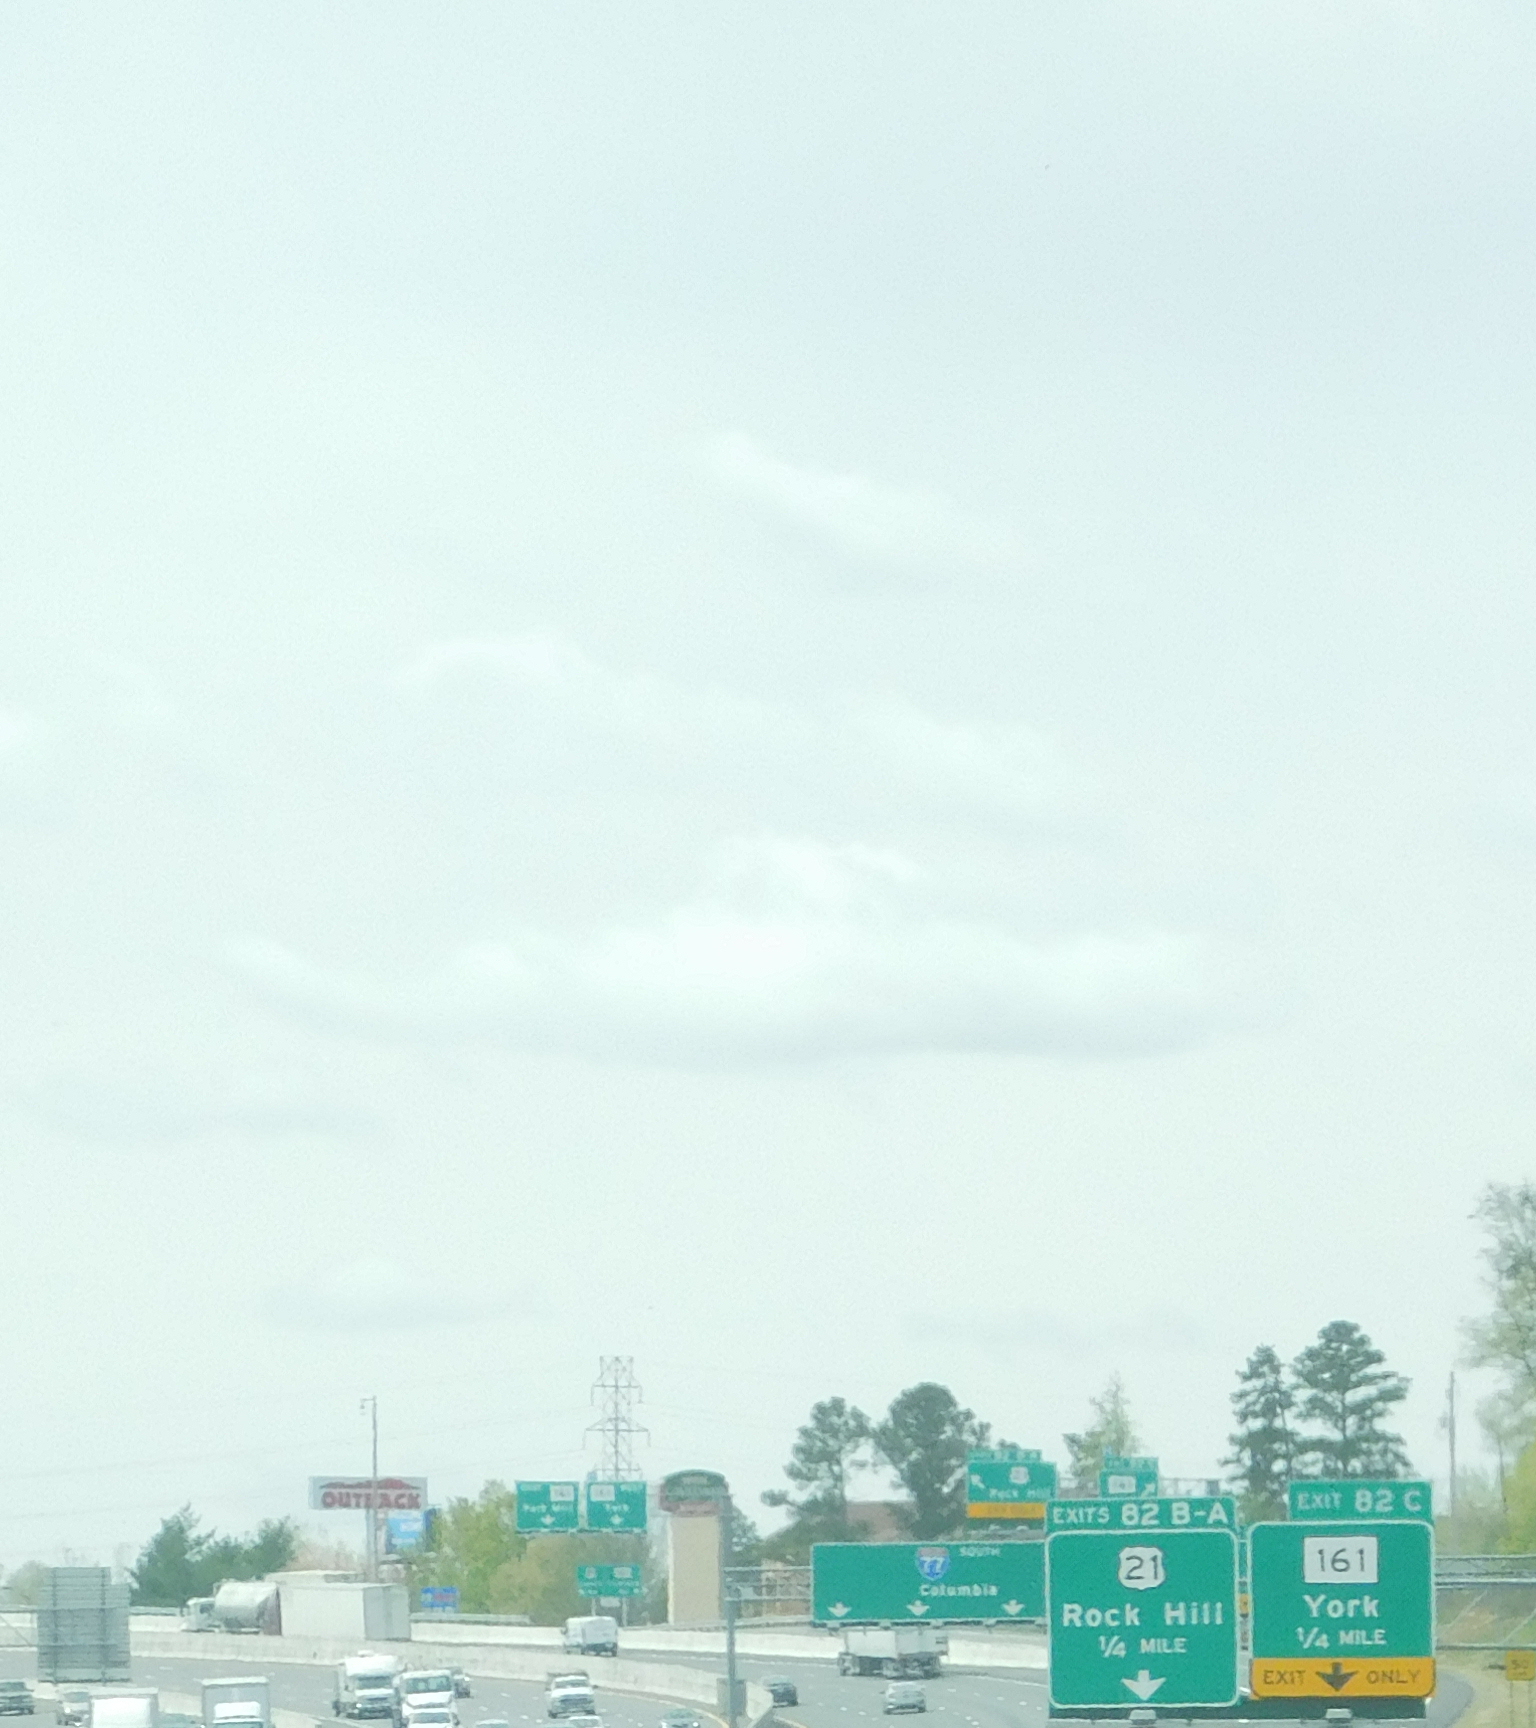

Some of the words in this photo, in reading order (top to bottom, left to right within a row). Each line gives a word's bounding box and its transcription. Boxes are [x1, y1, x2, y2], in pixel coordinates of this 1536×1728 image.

[1298, 1491, 1343, 1511] EXIT
[1355, 1488, 1395, 1513] 82
[1403, 1489, 1422, 1512] C
[1053, 1507, 1110, 1524] EXITS
[1120, 1502, 1161, 1526] 82
[1171, 1501, 1229, 1525] B-A
[919, 1556, 946, 1574] 77
[1124, 1554, 1159, 1581] 21
[1317, 1548, 1366, 1573] 161
[919, 1584, 999, 1597] Columbia
[1062, 1603, 1141, 1628] Rock
[1164, 1602, 1224, 1627] Hill
[1302, 1594, 1380, 1619] York
[1138, 1637, 1188, 1654] MILE
[1339, 1628, 1387, 1645] MILE
[1263, 1669, 1306, 1685] EXIT
[1366, 1669, 1421, 1685] ONLY
